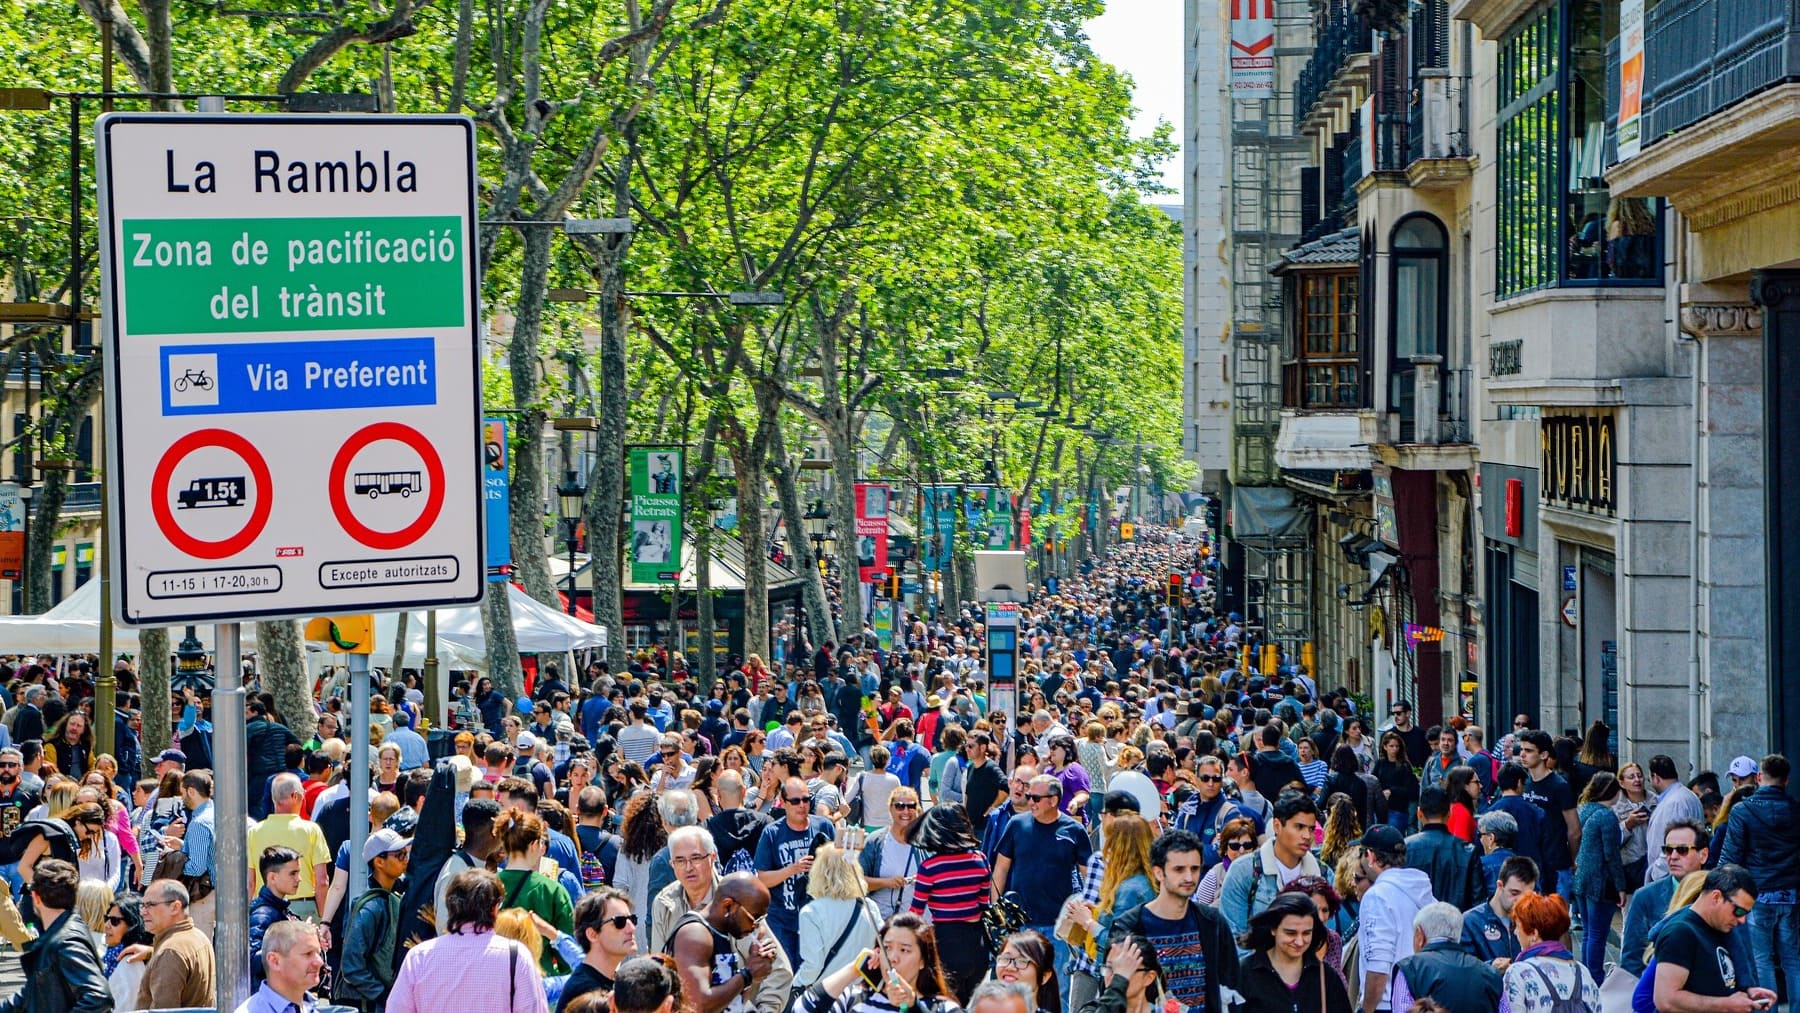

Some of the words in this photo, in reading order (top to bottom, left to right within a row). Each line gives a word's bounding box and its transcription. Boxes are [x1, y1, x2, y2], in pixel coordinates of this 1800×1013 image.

[166, 149, 217, 194] La
[254, 150, 417, 194] Rambla
[132, 233, 212, 267] Zona
[231, 232, 269, 266] de
[288, 229, 455, 272] pacificació
[210, 285, 259, 320] del
[278, 283, 386, 318] trànsit
[246, 363, 288, 391] Via
[305, 359, 427, 389] Preferent
[204, 482, 238, 500] 1.5t
[634, 505, 677, 517] Retrats
[162, 576, 195, 592] 11-15
[202, 576, 207, 590] i
[263, 575, 269, 587] h
[331, 567, 378, 584] Excepte
[385, 563, 448, 579] autoritzats
